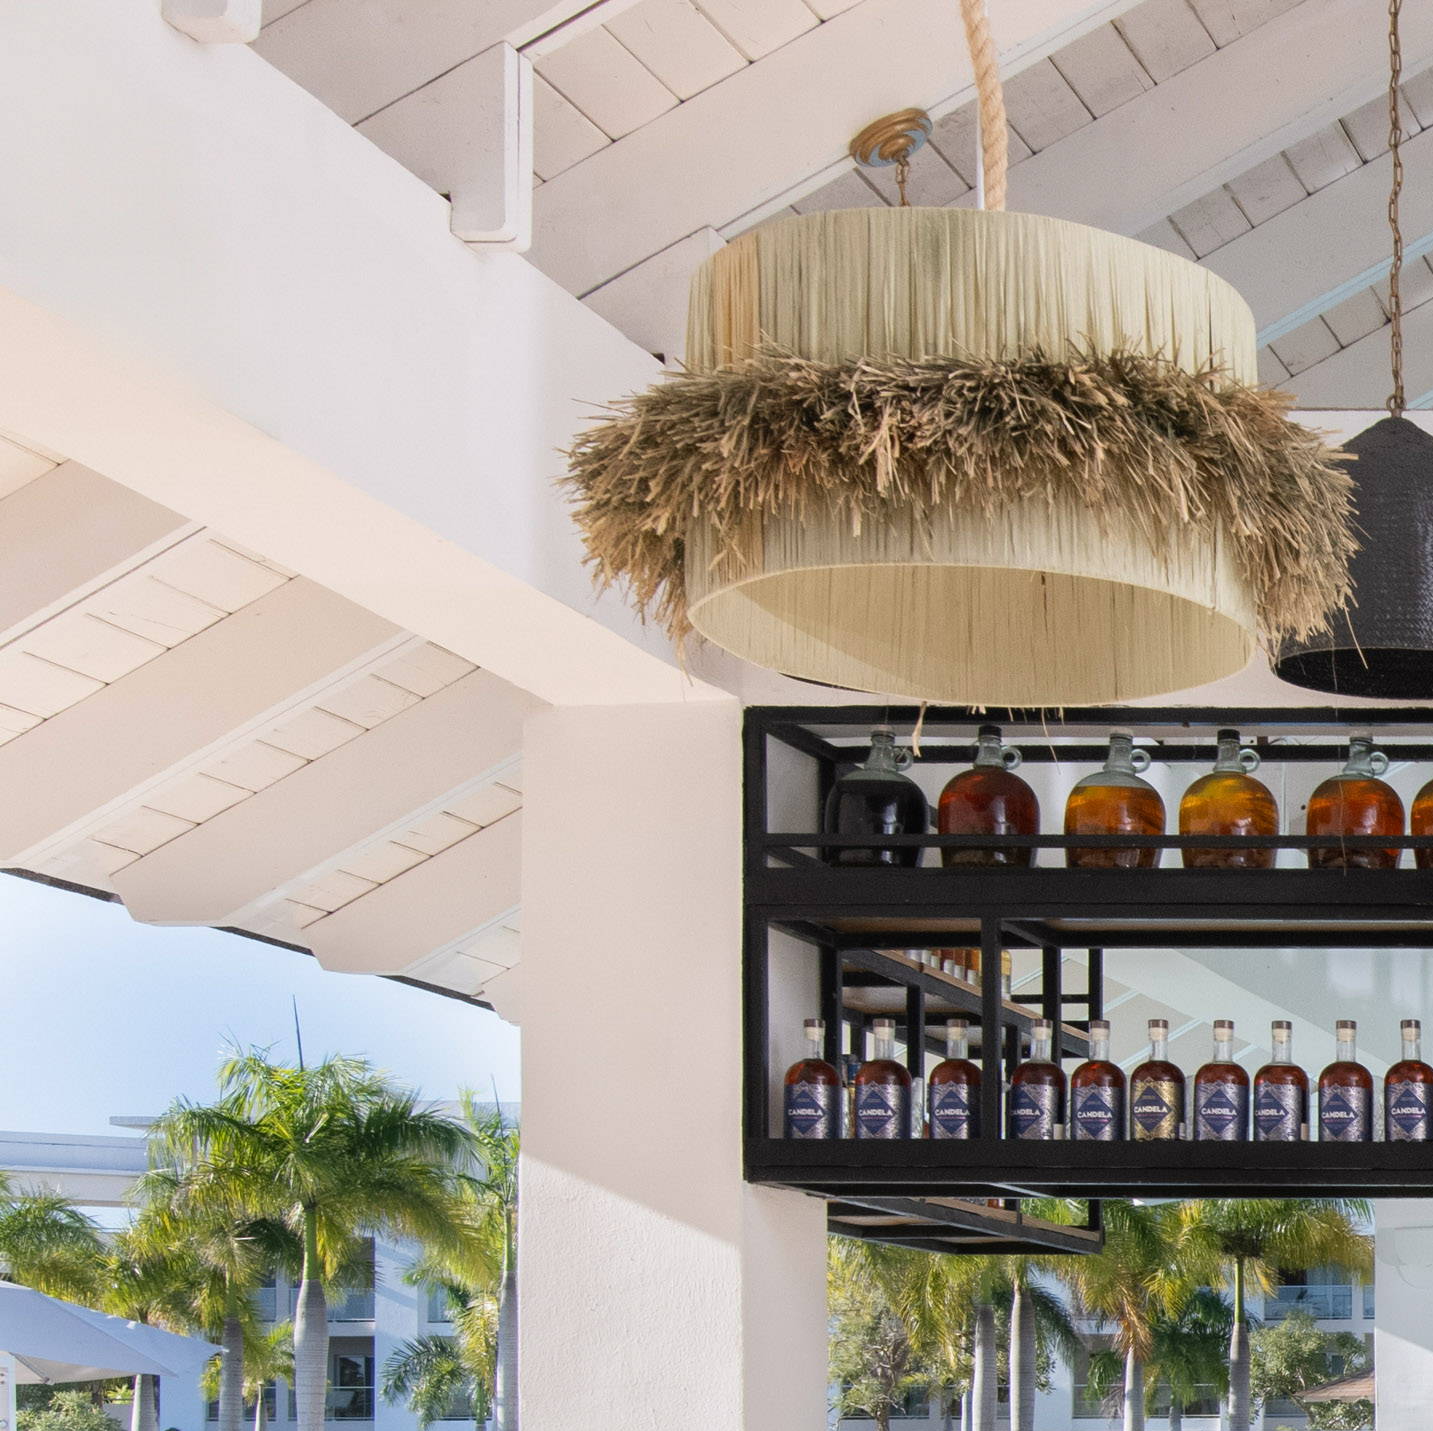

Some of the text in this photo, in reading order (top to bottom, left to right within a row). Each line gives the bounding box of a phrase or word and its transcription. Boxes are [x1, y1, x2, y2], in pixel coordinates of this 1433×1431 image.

[787, 1108, 824, 1117] CANDELA
[857, 1108, 894, 1118] CANDELA
[933, 1108, 971, 1117] CANDELA
[1010, 1108, 1041, 1117] CANDELA
[1132, 1104, 1168, 1114] CANDELA
[1200, 1107, 1237, 1117] CANDELA
[1254, 1108, 1286, 1118] CANDELA
[1390, 1106, 1427, 1117] CANDELA
[1076, 1110, 1113, 1120] CANDELA
[1320, 1110, 1355, 1120] CANDELA
